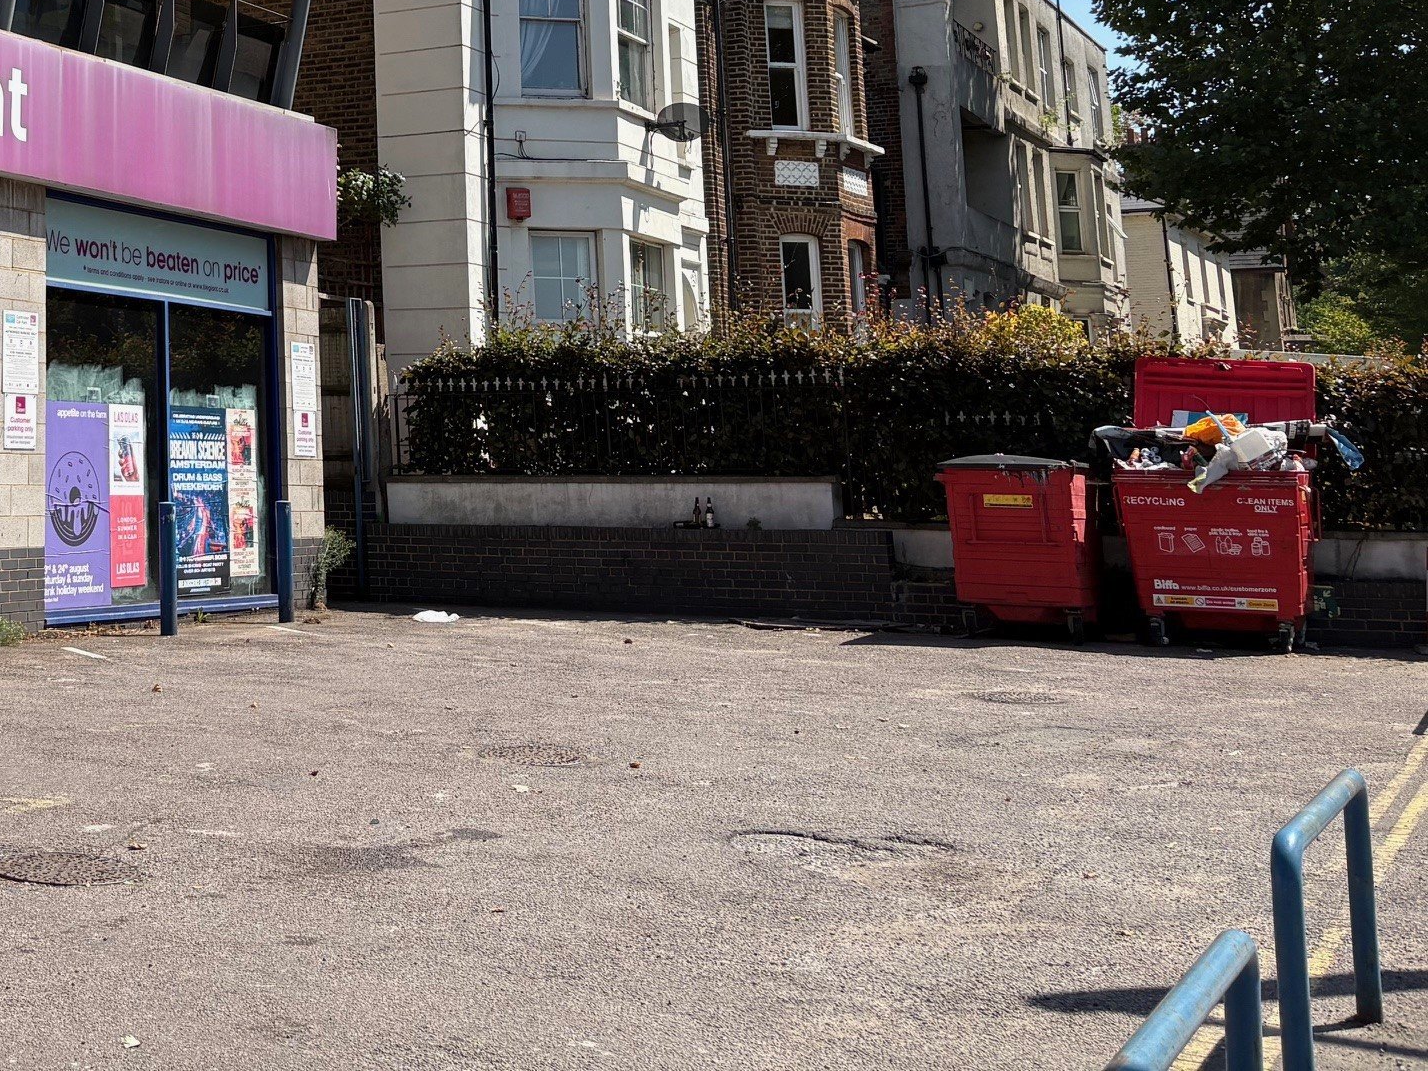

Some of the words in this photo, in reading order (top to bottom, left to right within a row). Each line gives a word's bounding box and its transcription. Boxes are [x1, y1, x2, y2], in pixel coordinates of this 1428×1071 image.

[46, 229, 70, 255] We
[74, 238, 118, 262] won't
[121, 241, 142, 266] be
[146, 245, 199, 275] beaten
[203, 259, 220, 278] on
[56, 408, 79, 419] appetite
[197, 441, 226, 461] SCIENCE
[170, 460, 226, 469] AMSTERDAM
[173, 473, 196, 482] DRUM
[196, 473, 203, 481] &
[202, 472, 223, 481] BASS
[173, 482, 224, 491] WEEKENDER
[1123, 495, 1186, 507] RECYCLING
[1267, 497, 1295, 507] ITEMS
[1254, 504, 1278, 514] ONLY
[69, 563, 90, 575] august
[56, 584, 78, 597] holiday
[77, 582, 104, 594] weekend
[1153, 578, 1180, 590] Biffa
[1181, 584, 1278, 593] www.biffa.co.uk/customerzone
